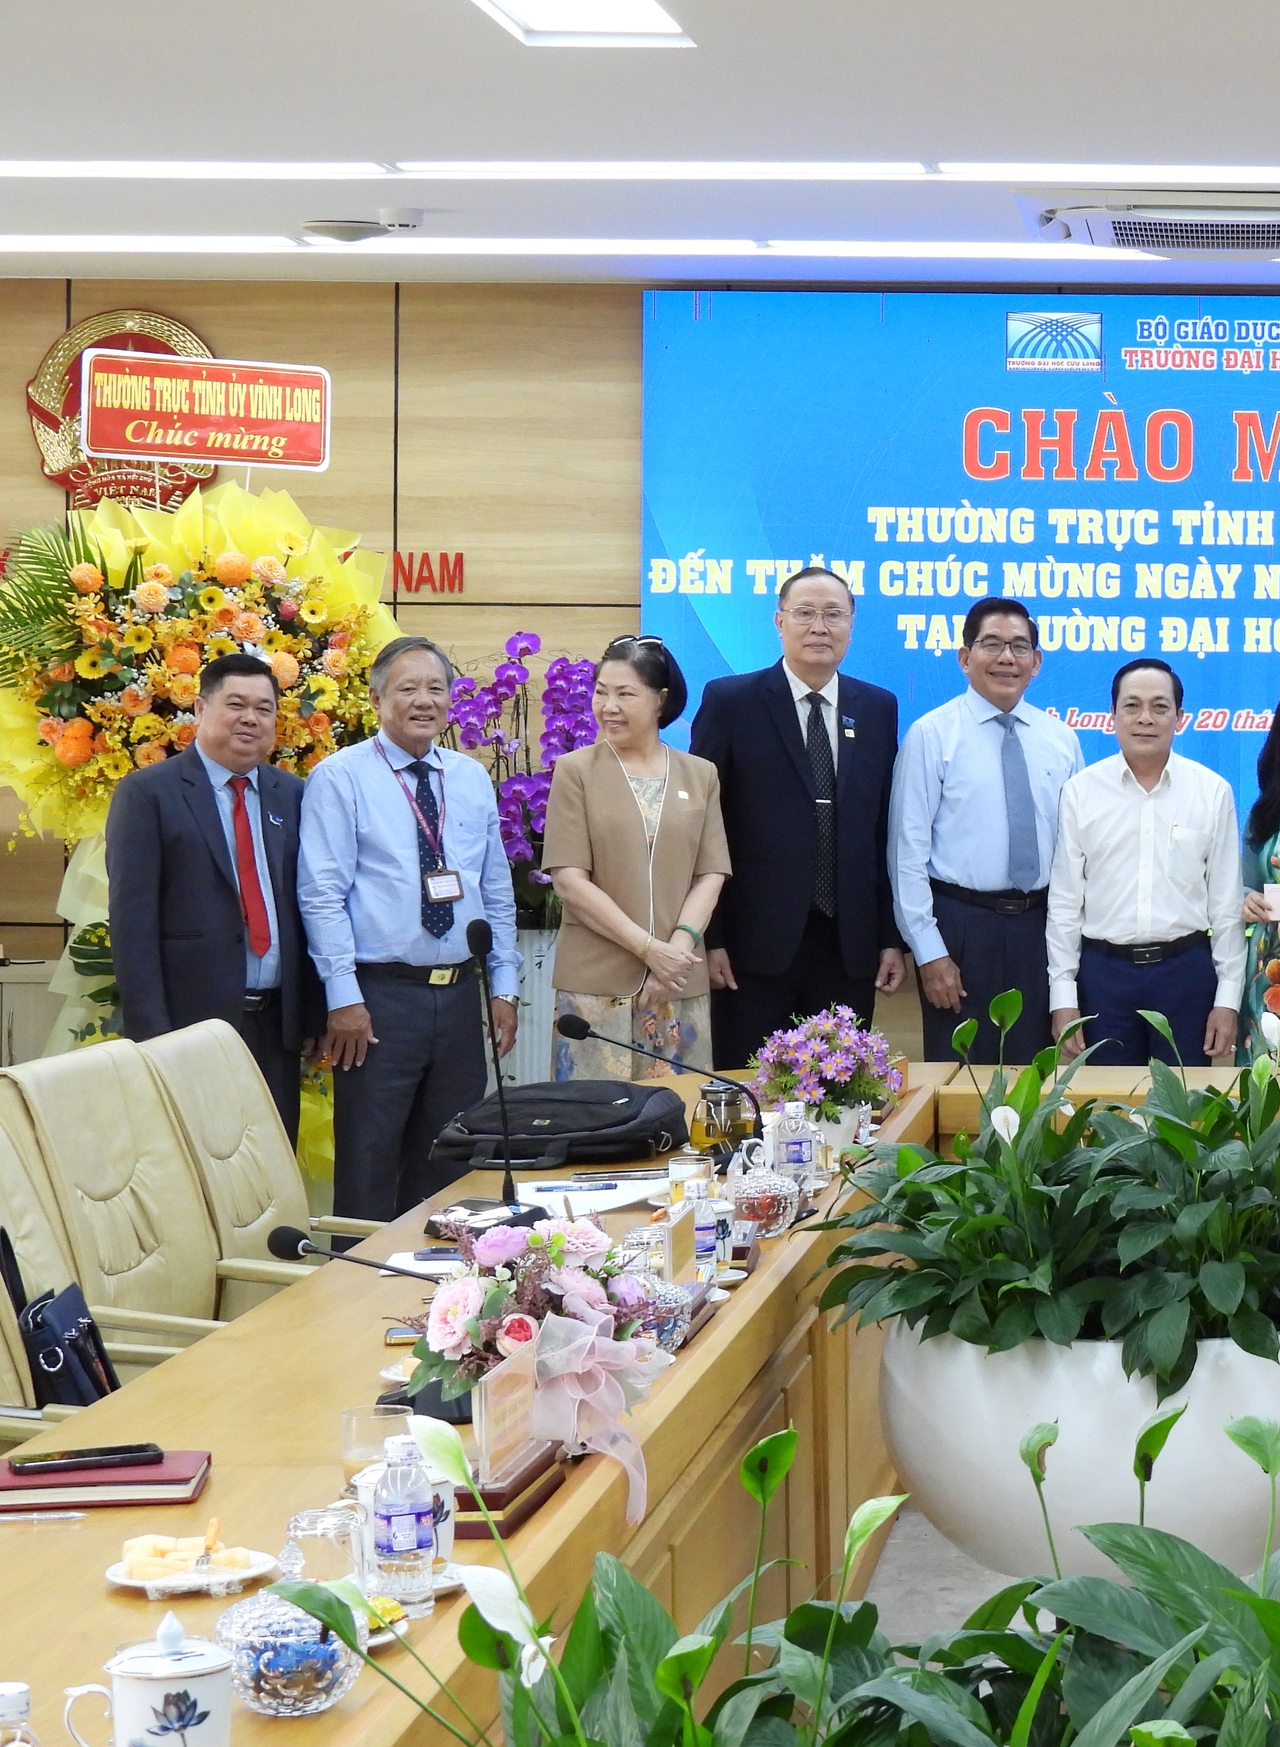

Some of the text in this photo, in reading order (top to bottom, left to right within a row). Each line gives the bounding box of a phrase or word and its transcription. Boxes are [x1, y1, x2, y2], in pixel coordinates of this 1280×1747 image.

[1138, 317, 1167, 345] BỘ
[1176, 317, 1228, 340] GIÁO
[1236, 322, 1280, 346] DỤC
[1124, 345, 1215, 369] TRƯỜNG
[1224, 350, 1262, 373] ĐẠI
[94, 367, 321, 423] THƯỜNG TRỰC TỈNH ỦY VĨNH LONG
[124, 420, 288, 458] Chúc mừng
[962, 391, 1194, 482] CHÀO
[867, 499, 1036, 545] THƯỜNG
[1048, 508, 1159, 552] TRỰC
[1172, 501, 1273, 546] TỈNH
[393, 551, 463, 593] NAM
[648, 548, 733, 595] ĐẾN
[879, 553, 988, 598] CHÚC
[1002, 553, 1128, 599] MỪNG
[1135, 556, 1241, 600] NGÀY
[897, 614, 966, 657] TẠI
[1036, 607, 1149, 652] ƯỜNG
[1159, 616, 1230, 659] ĐẠI
[1067, 709, 1115, 732] Long
[1196, 710, 1225, 730] 20
[1234, 711, 1275, 730] thá
